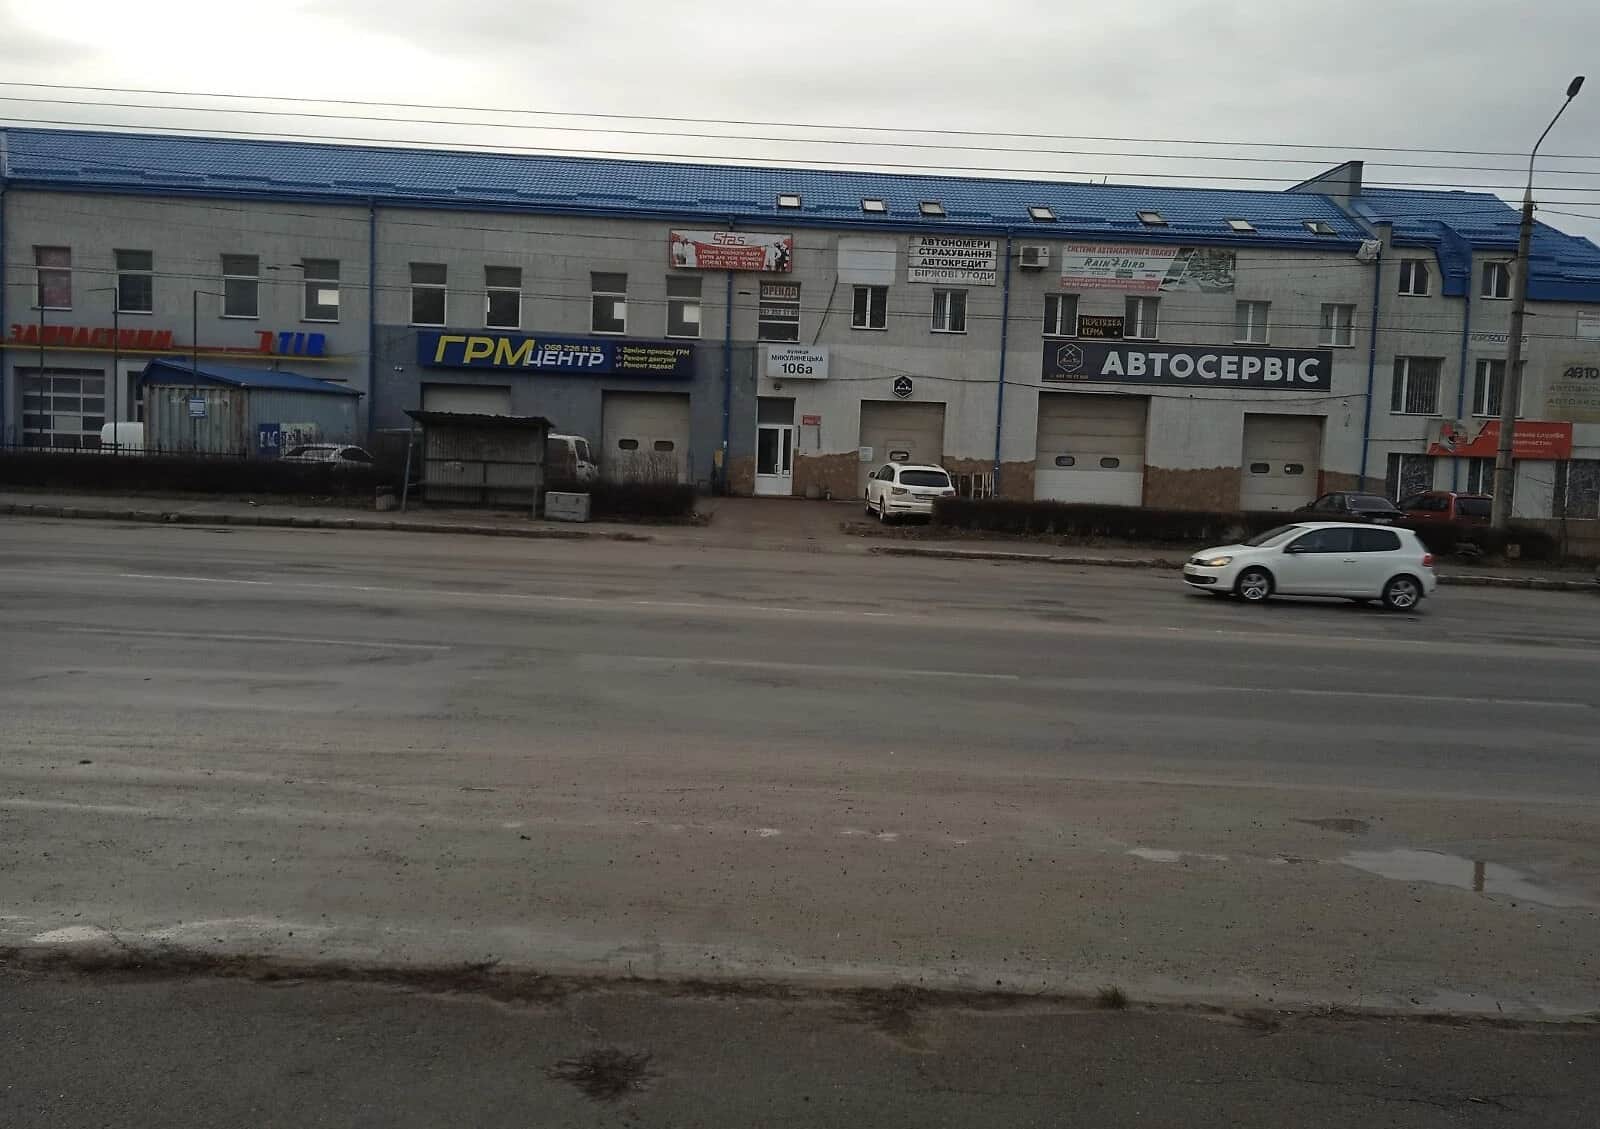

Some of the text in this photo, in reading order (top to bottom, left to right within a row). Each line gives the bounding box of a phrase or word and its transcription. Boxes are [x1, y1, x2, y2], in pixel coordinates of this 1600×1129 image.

[921, 238, 991, 249] АВТОНОМЕРИ
[919, 248, 992, 258] СТРАХУВАННЯ
[921, 258, 989, 269] АВТОКРЕДИТ
[914, 269, 995, 281] БІРЖОВІ УГОДИ
[434, 335, 536, 367] ГРМ
[527, 350, 605, 367] ЦЕНТР
[1100, 350, 1321, 382] АВТОСЕРВІС
